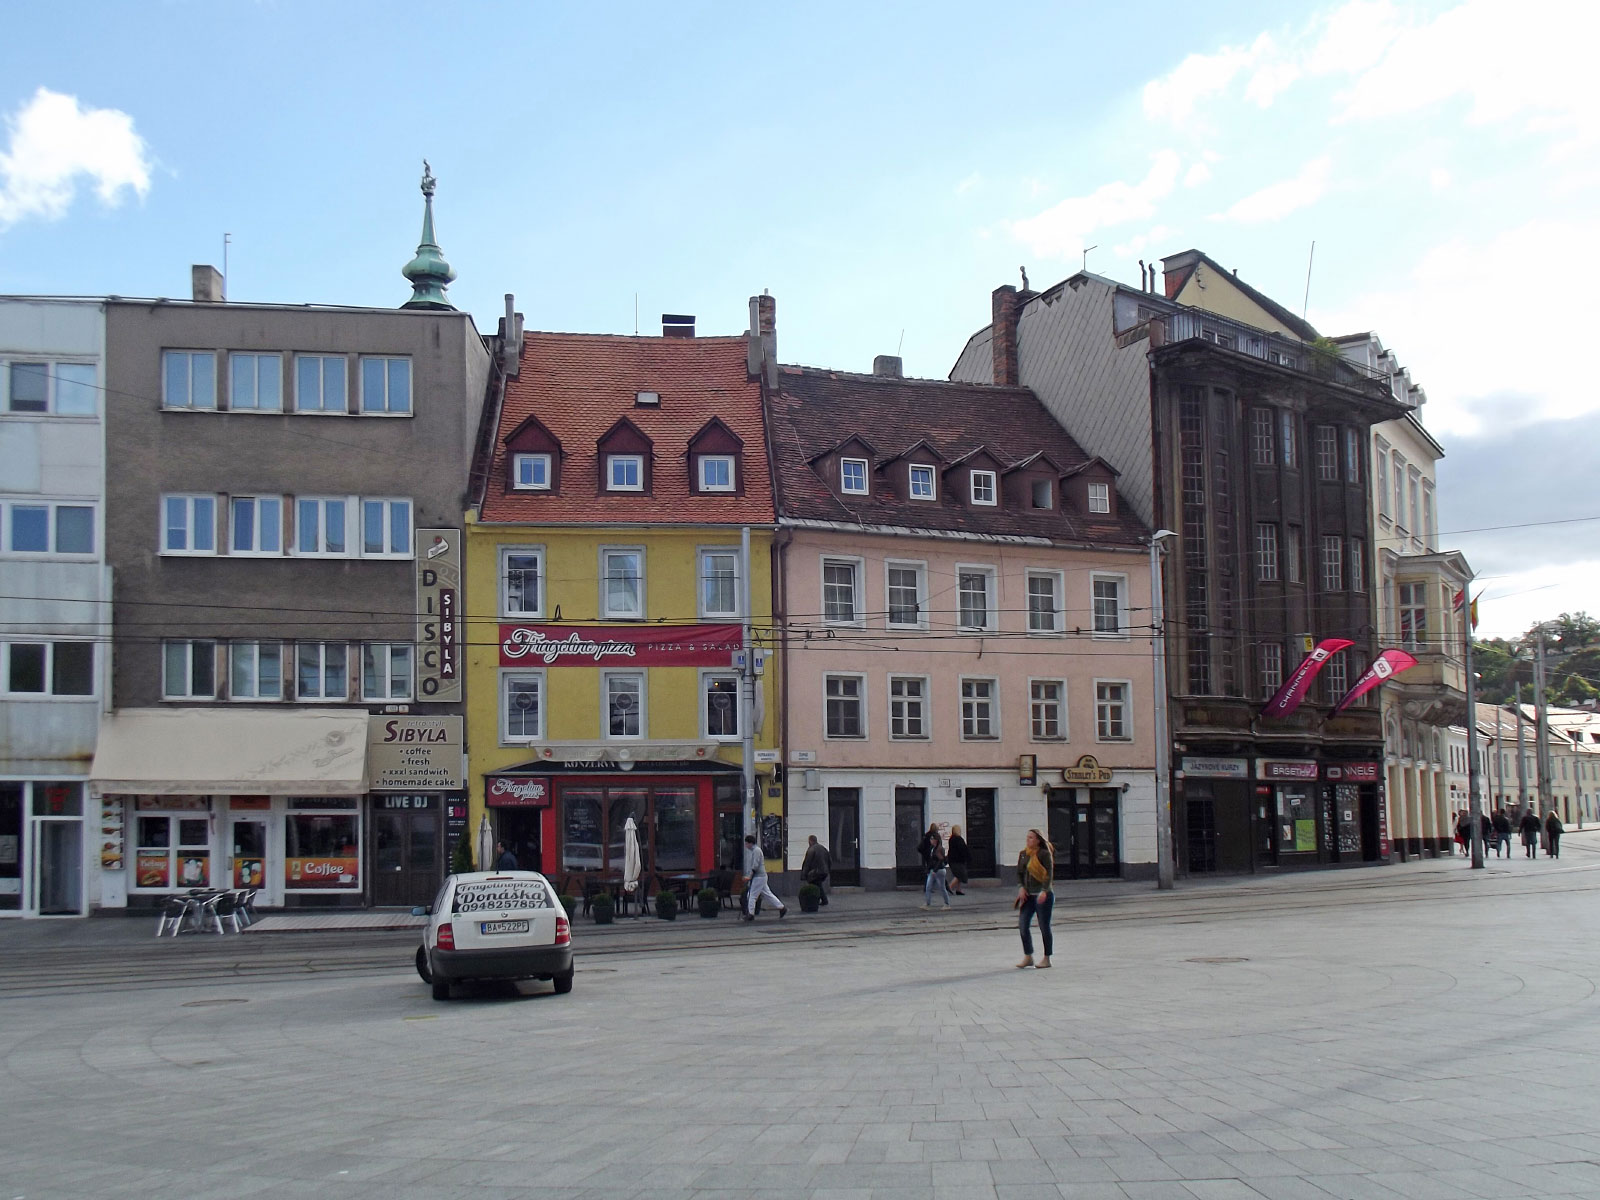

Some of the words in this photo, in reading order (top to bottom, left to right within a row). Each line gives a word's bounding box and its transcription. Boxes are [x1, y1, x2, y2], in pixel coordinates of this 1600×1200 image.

[422, 569, 439, 696] DISCO
[648, 643, 681, 651] PIZZA
[689, 643, 695, 651] &
[702, 643, 740, 651] SALAD
[1279, 659, 1314, 708] CHANNELS
[405, 747, 432, 755] coffee
[407, 758, 430, 766] fresh
[409, 767, 449, 776] sandwich
[382, 778, 433, 786] homemade
[435, 778, 455, 786] cake
[385, 796, 409, 808] LIVE
[414, 796, 428, 808] DJ
[304, 862, 345, 876] Coffee
[462, 901, 544, 913] 0948257857
